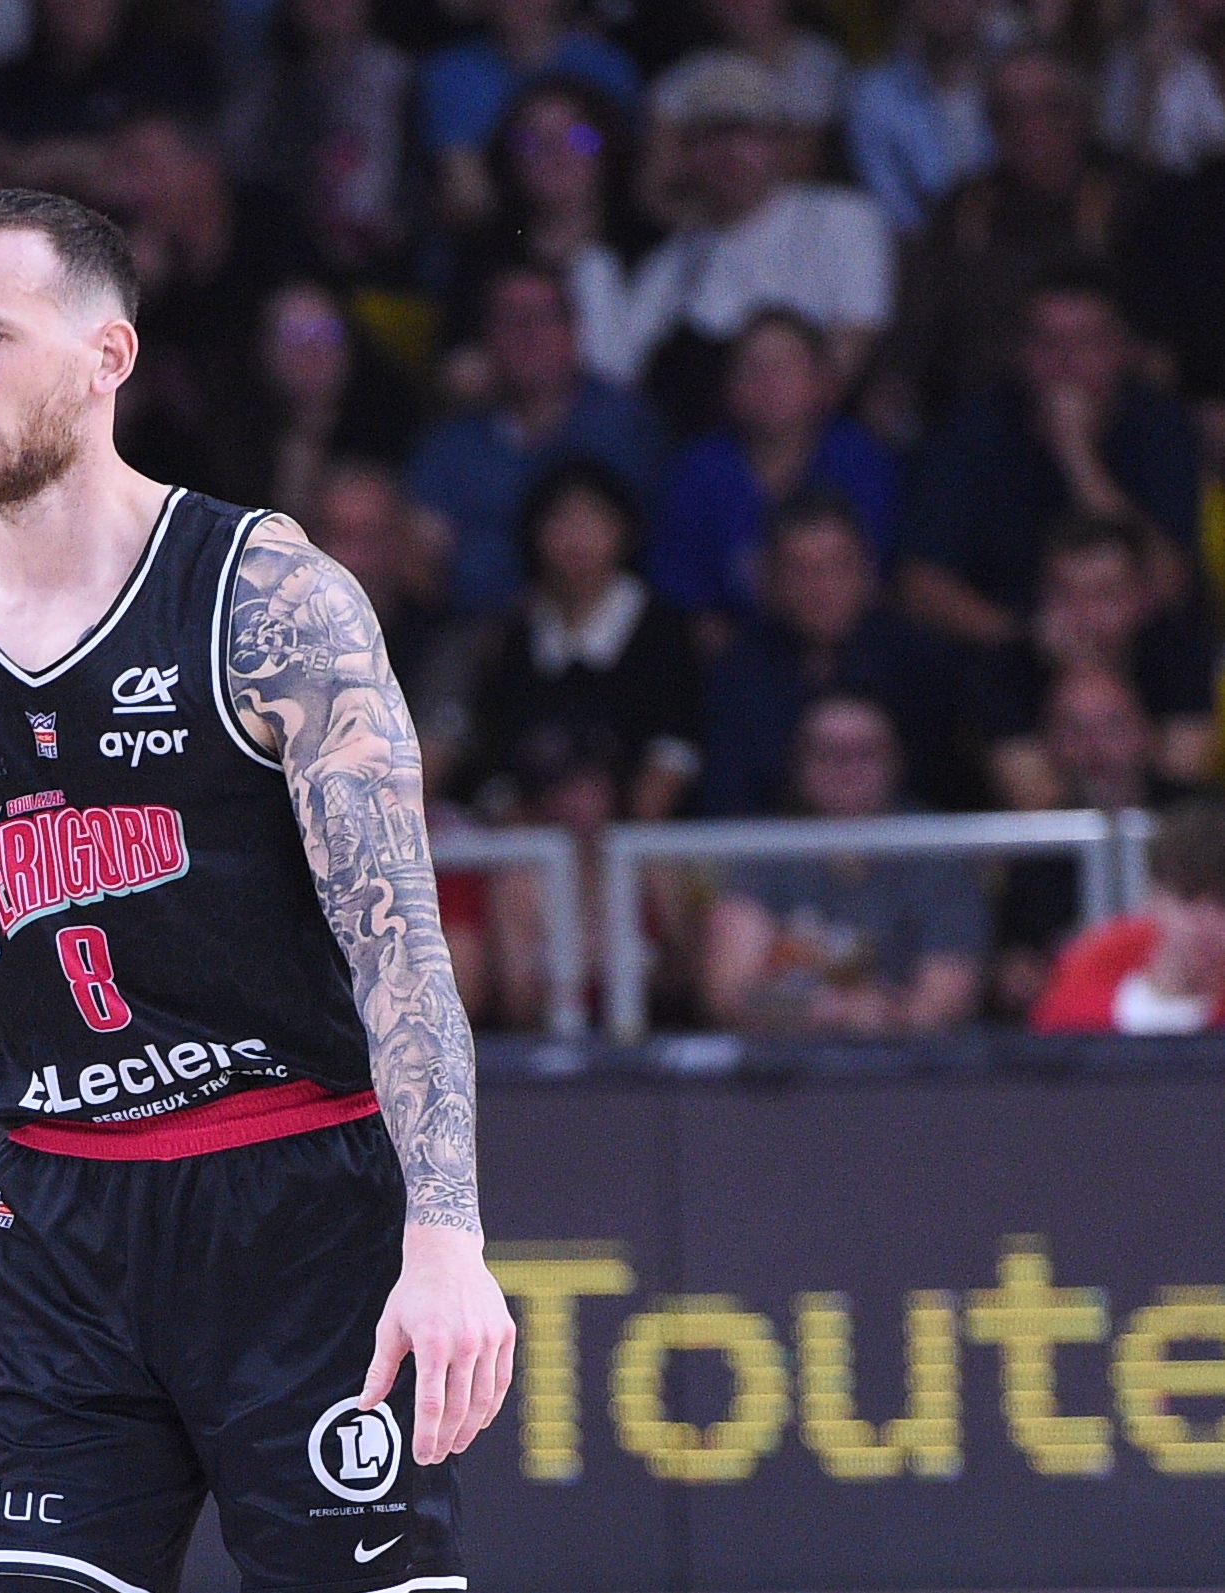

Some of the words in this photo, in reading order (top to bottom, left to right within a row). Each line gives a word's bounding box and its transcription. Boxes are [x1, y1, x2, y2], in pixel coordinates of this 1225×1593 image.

[99, 728, 189, 768] ayor
[6, 789, 66, 818] BOULAZAC
[56, 925, 133, 1033] 8
[483, 1232, 1225, 1484] Toute
[309, 1506, 365, 1518] PERIGUEUX
